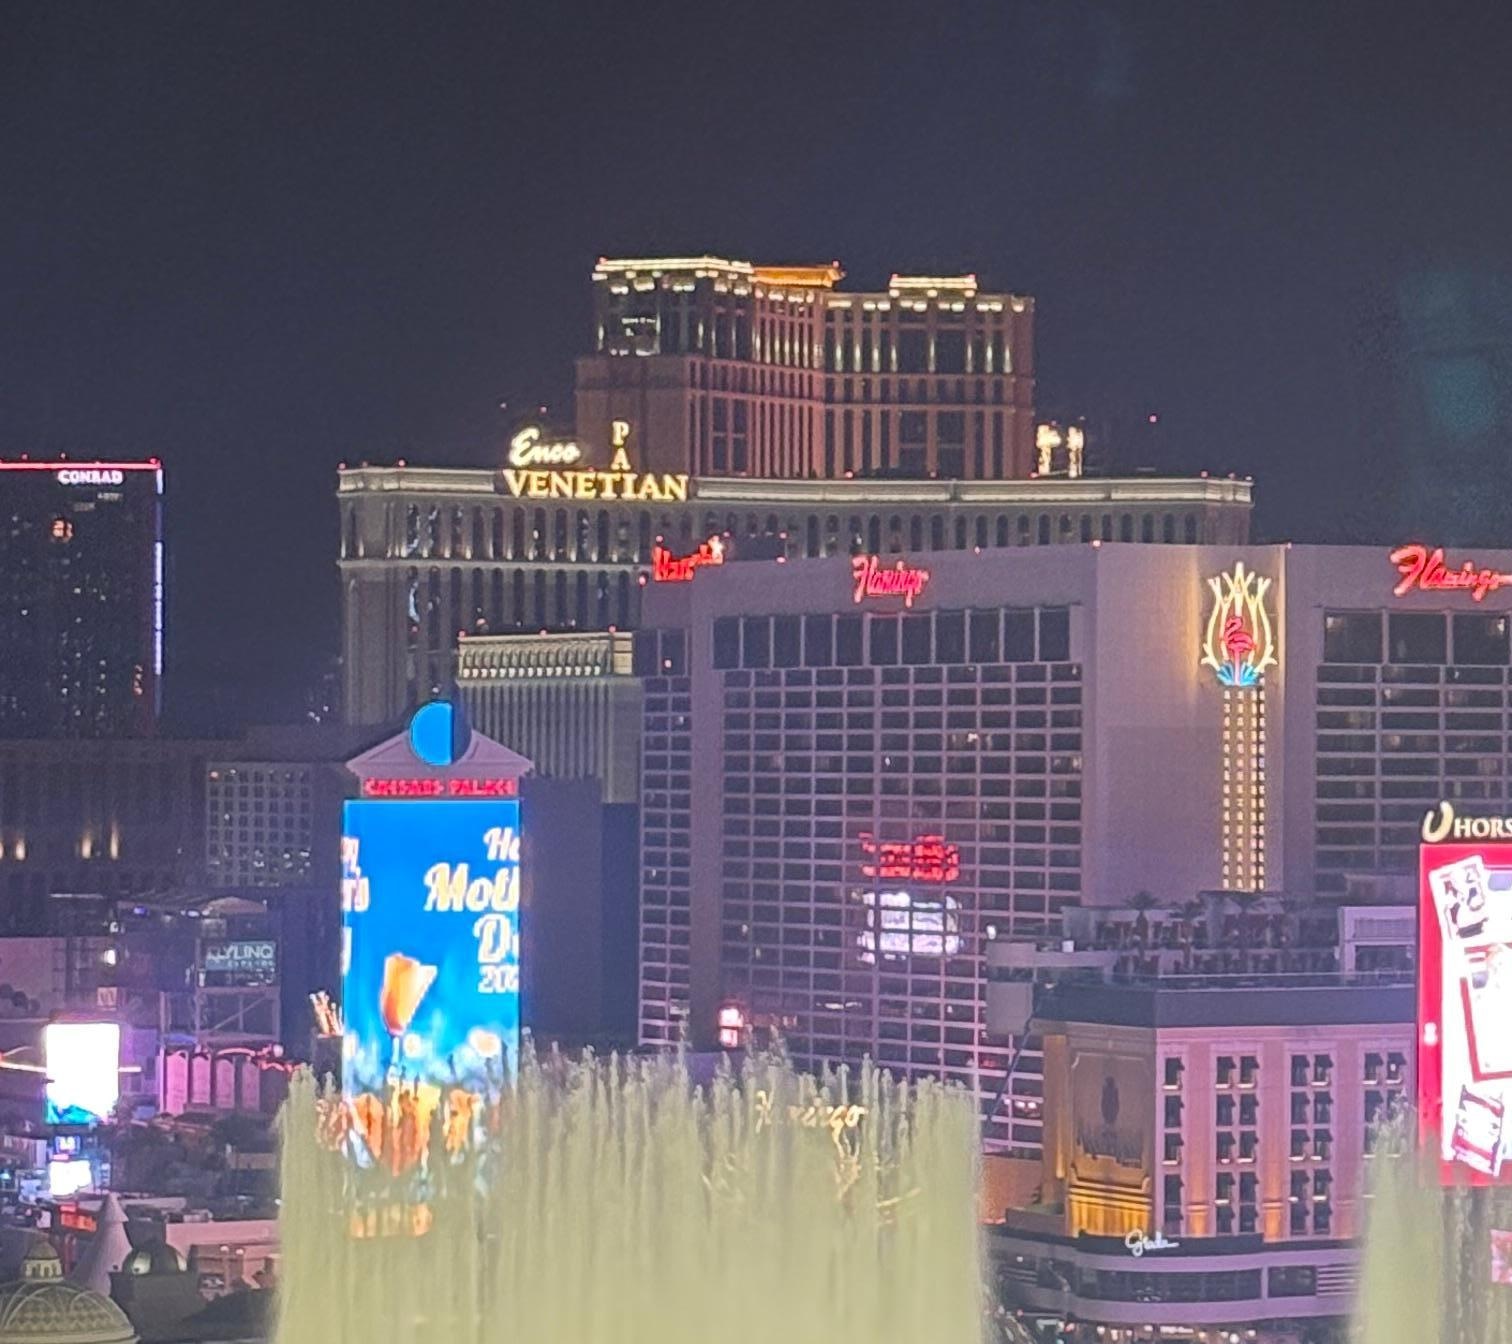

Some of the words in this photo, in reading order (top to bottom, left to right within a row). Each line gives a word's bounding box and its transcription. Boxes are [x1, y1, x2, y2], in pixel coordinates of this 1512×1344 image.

[57, 469, 123, 485] CONRAD
[502, 469, 688, 502] VENETIAN
[852, 555, 929, 608] Flamingo
